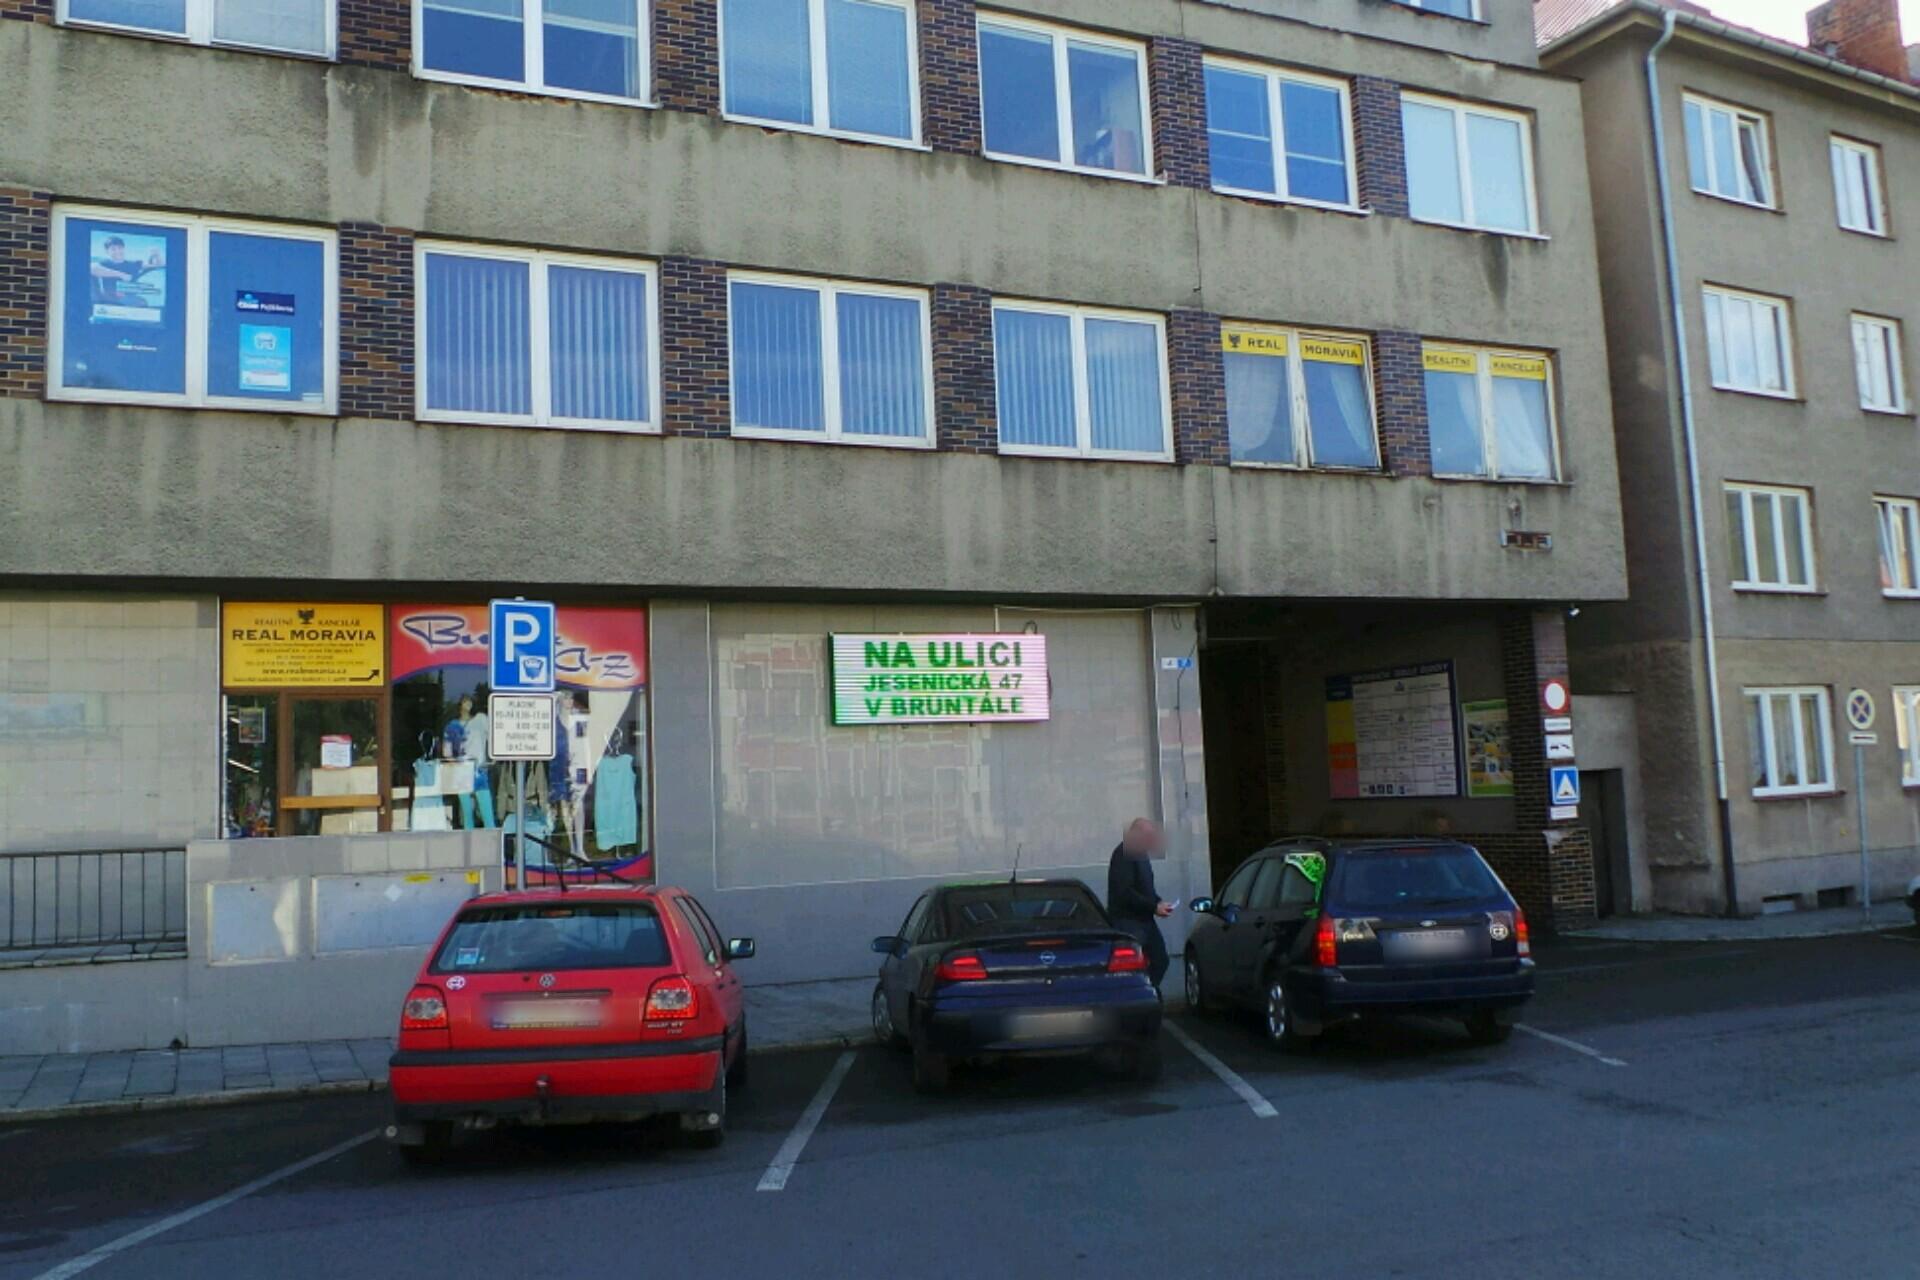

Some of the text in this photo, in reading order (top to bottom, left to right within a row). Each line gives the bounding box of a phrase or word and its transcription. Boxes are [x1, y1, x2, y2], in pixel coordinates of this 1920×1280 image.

[1247, 337, 1359, 359] REAL MORAVIA
[232, 629, 377, 641] REAL MORAVIA
[505, 612, 541, 662] P
[864, 641, 1022, 668] NA ULICI
[864, 670, 1023, 692] JESENICKÁ 47
[864, 691, 1025, 718] V BRUNTÁLE
